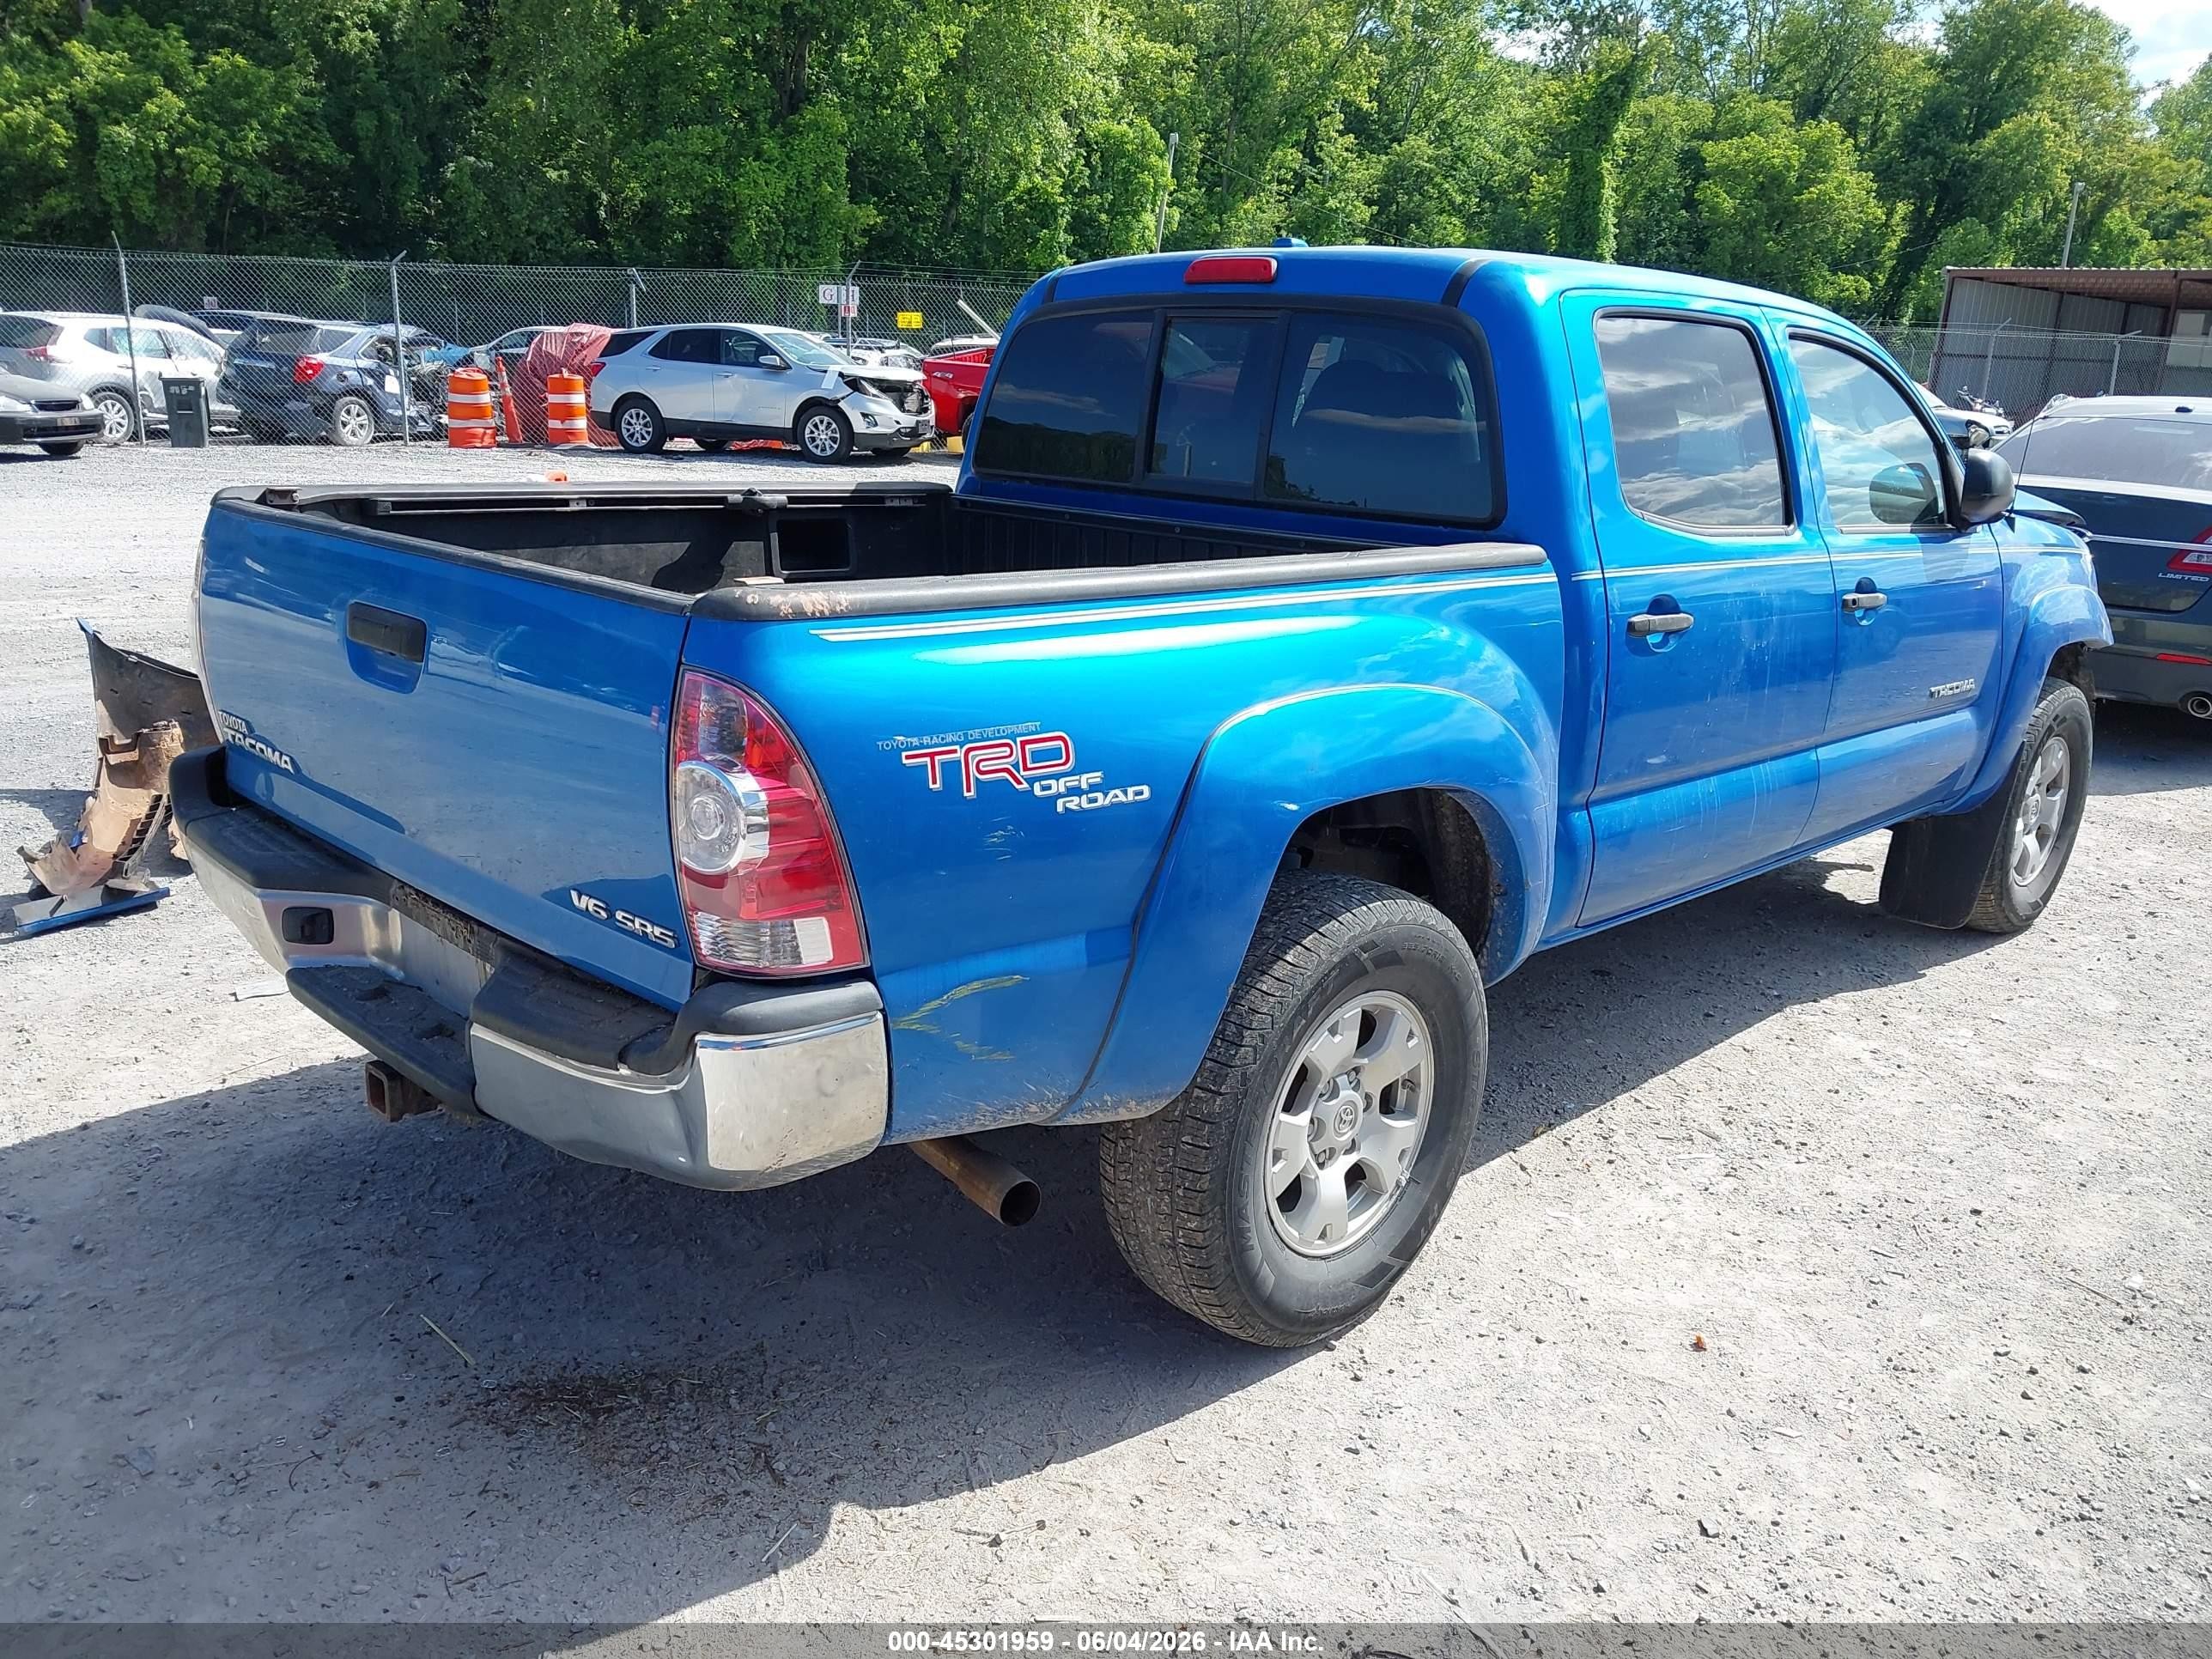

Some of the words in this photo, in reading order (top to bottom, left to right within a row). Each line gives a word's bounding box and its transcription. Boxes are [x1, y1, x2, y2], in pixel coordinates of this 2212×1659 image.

[823, 288, 834, 301] G
[2157, 572, 2210, 582] LIMITED
[1929, 678, 1975, 698] TACOMA
[217, 710, 249, 734] TOYOTA
[968, 721, 1041, 739] DEVELOPMENT
[223, 727, 295, 775] TACOMA
[902, 731, 1075, 799] TRD
[1033, 771, 1104, 797] OFF
[1056, 784, 1151, 814] ROAD
[569, 889, 611, 921] V6
[615, 909, 678, 949] SR5
